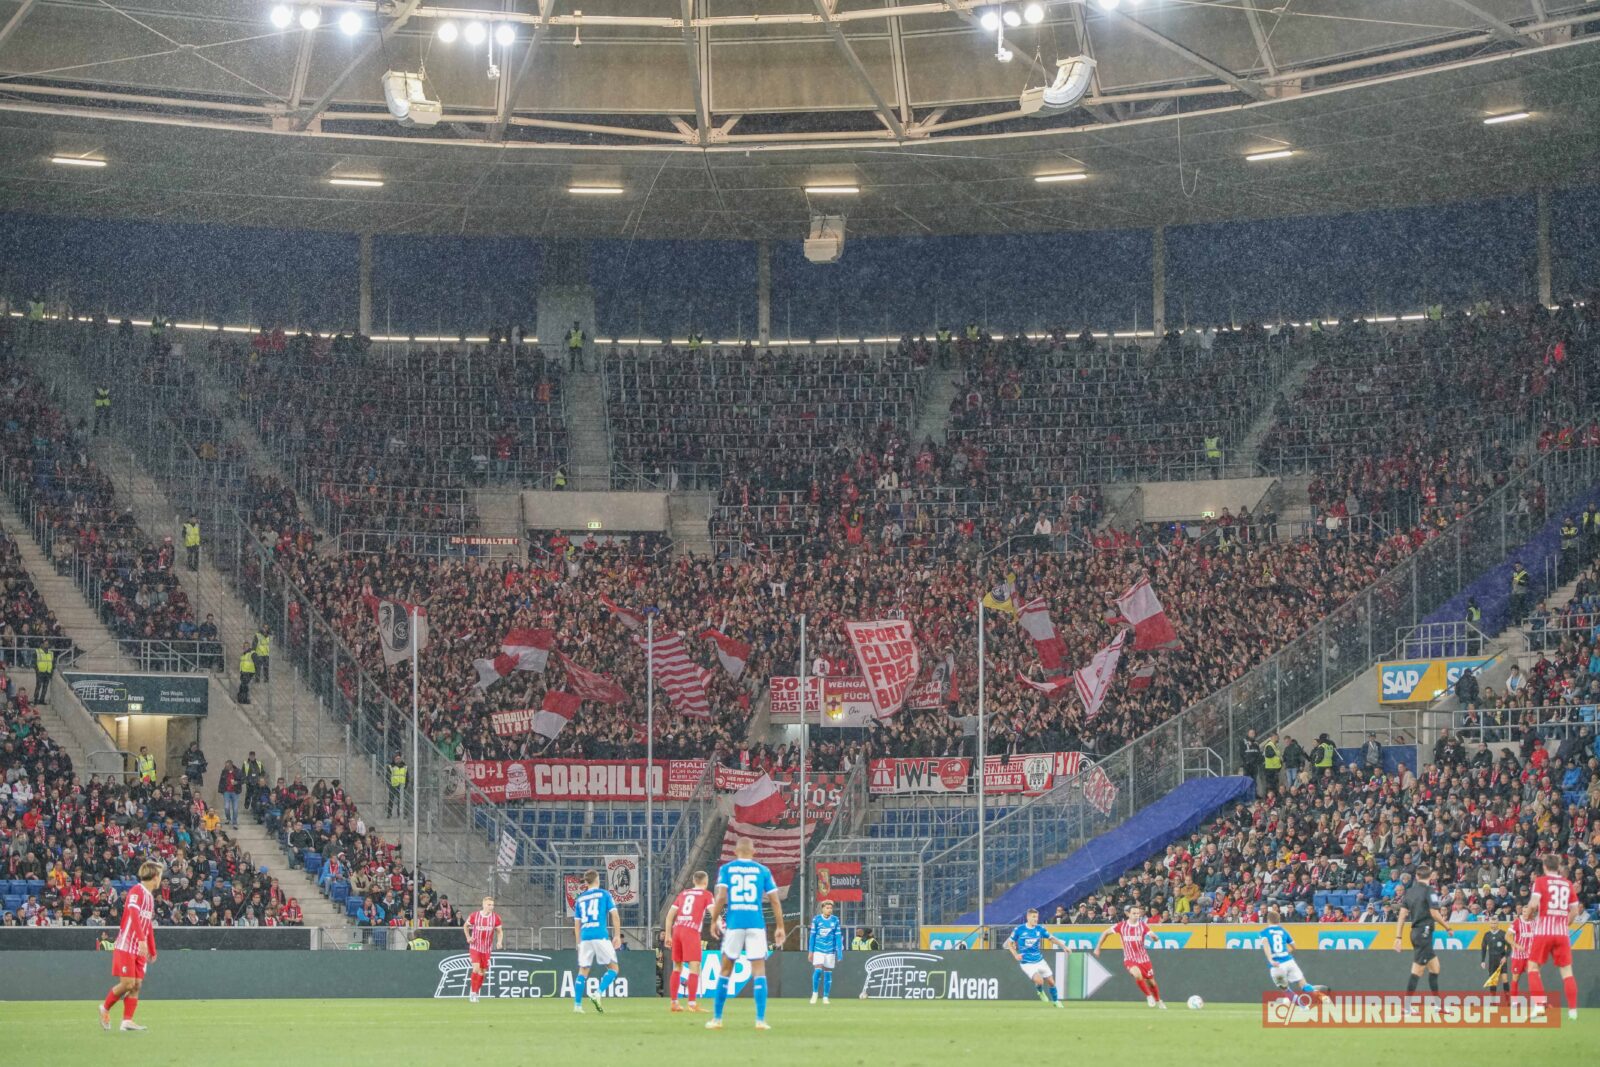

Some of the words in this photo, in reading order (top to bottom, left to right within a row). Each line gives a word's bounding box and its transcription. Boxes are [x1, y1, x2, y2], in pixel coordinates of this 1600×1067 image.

[853, 624, 906, 643] SPORT
[860, 640, 914, 666] CLUB
[867, 655, 915, 688] FREI
[98, 687, 115, 697] pre
[828, 681, 867, 689] WEINGA
[1382, 670, 1419, 695] SAP
[843, 692, 871, 700] FÜCH
[534, 764, 663, 795] CORRILLO
[896, 760, 939, 789] IWF
[985, 776, 1011, 785] ULTRAS
[730, 874, 757, 903] 25
[1548, 885, 1570, 910] 38
[579, 899, 599, 923] 14
[683, 895, 695, 915] 8
[1272, 934, 1284, 953] 8
[499, 970, 529, 984] pre
[905, 970, 927, 985] pre
[947, 971, 999, 999] Arena
[499, 987, 541, 997] zero
[905, 987, 935, 999] zero
